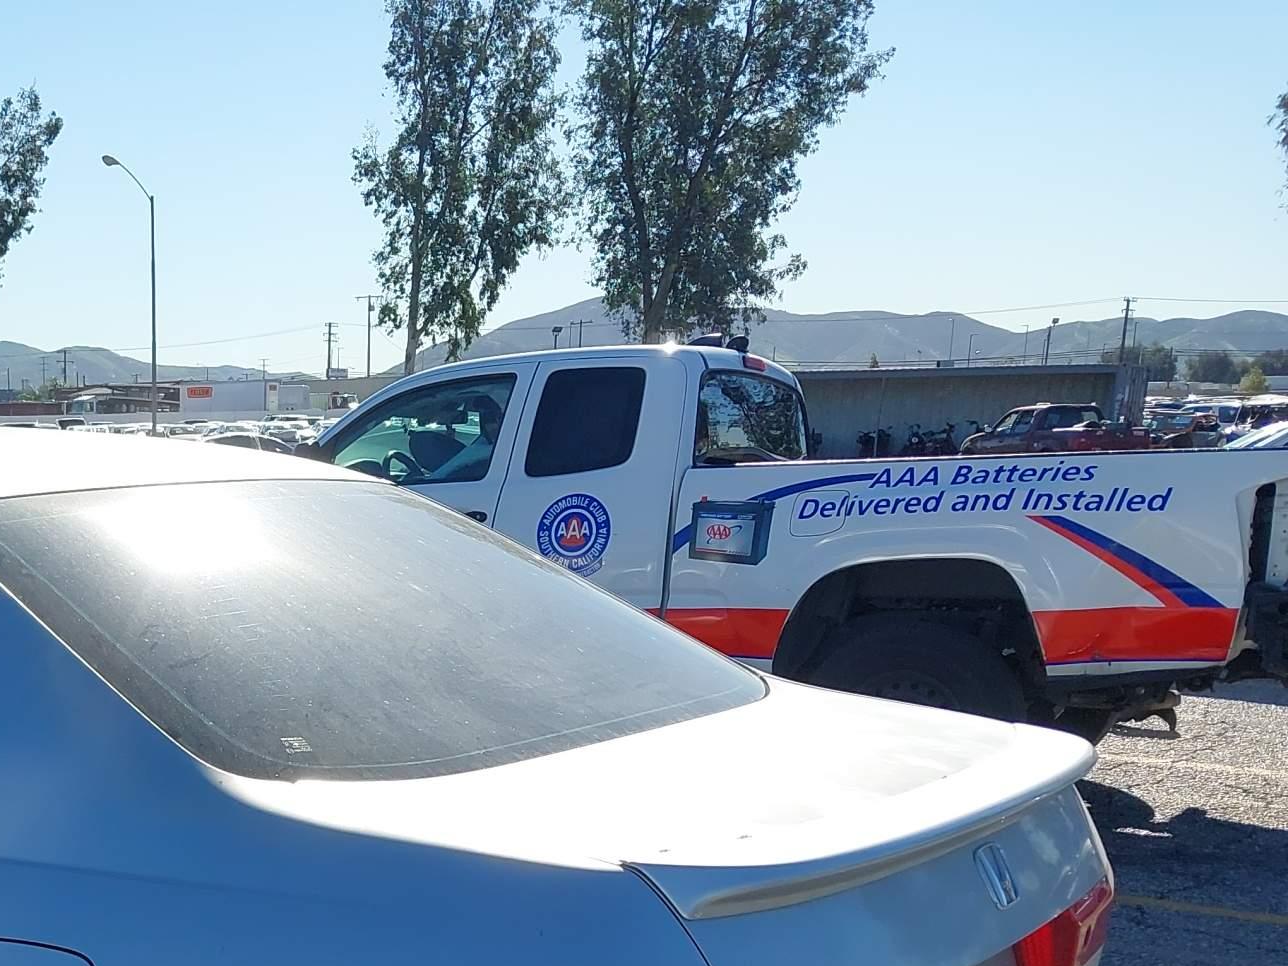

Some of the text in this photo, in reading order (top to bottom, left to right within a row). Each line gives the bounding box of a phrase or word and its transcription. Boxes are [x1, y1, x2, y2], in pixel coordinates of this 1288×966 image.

[869, 461, 1098, 488] AAA Batteries
[543, 496, 607, 526] AUTOMOBILE CLUB
[798, 487, 1173, 519] Delivered and Installed
[557, 520, 590, 540] AAA
[708, 525, 730, 539] AAA
[572, 528, 608, 569] CALIFORNIA
